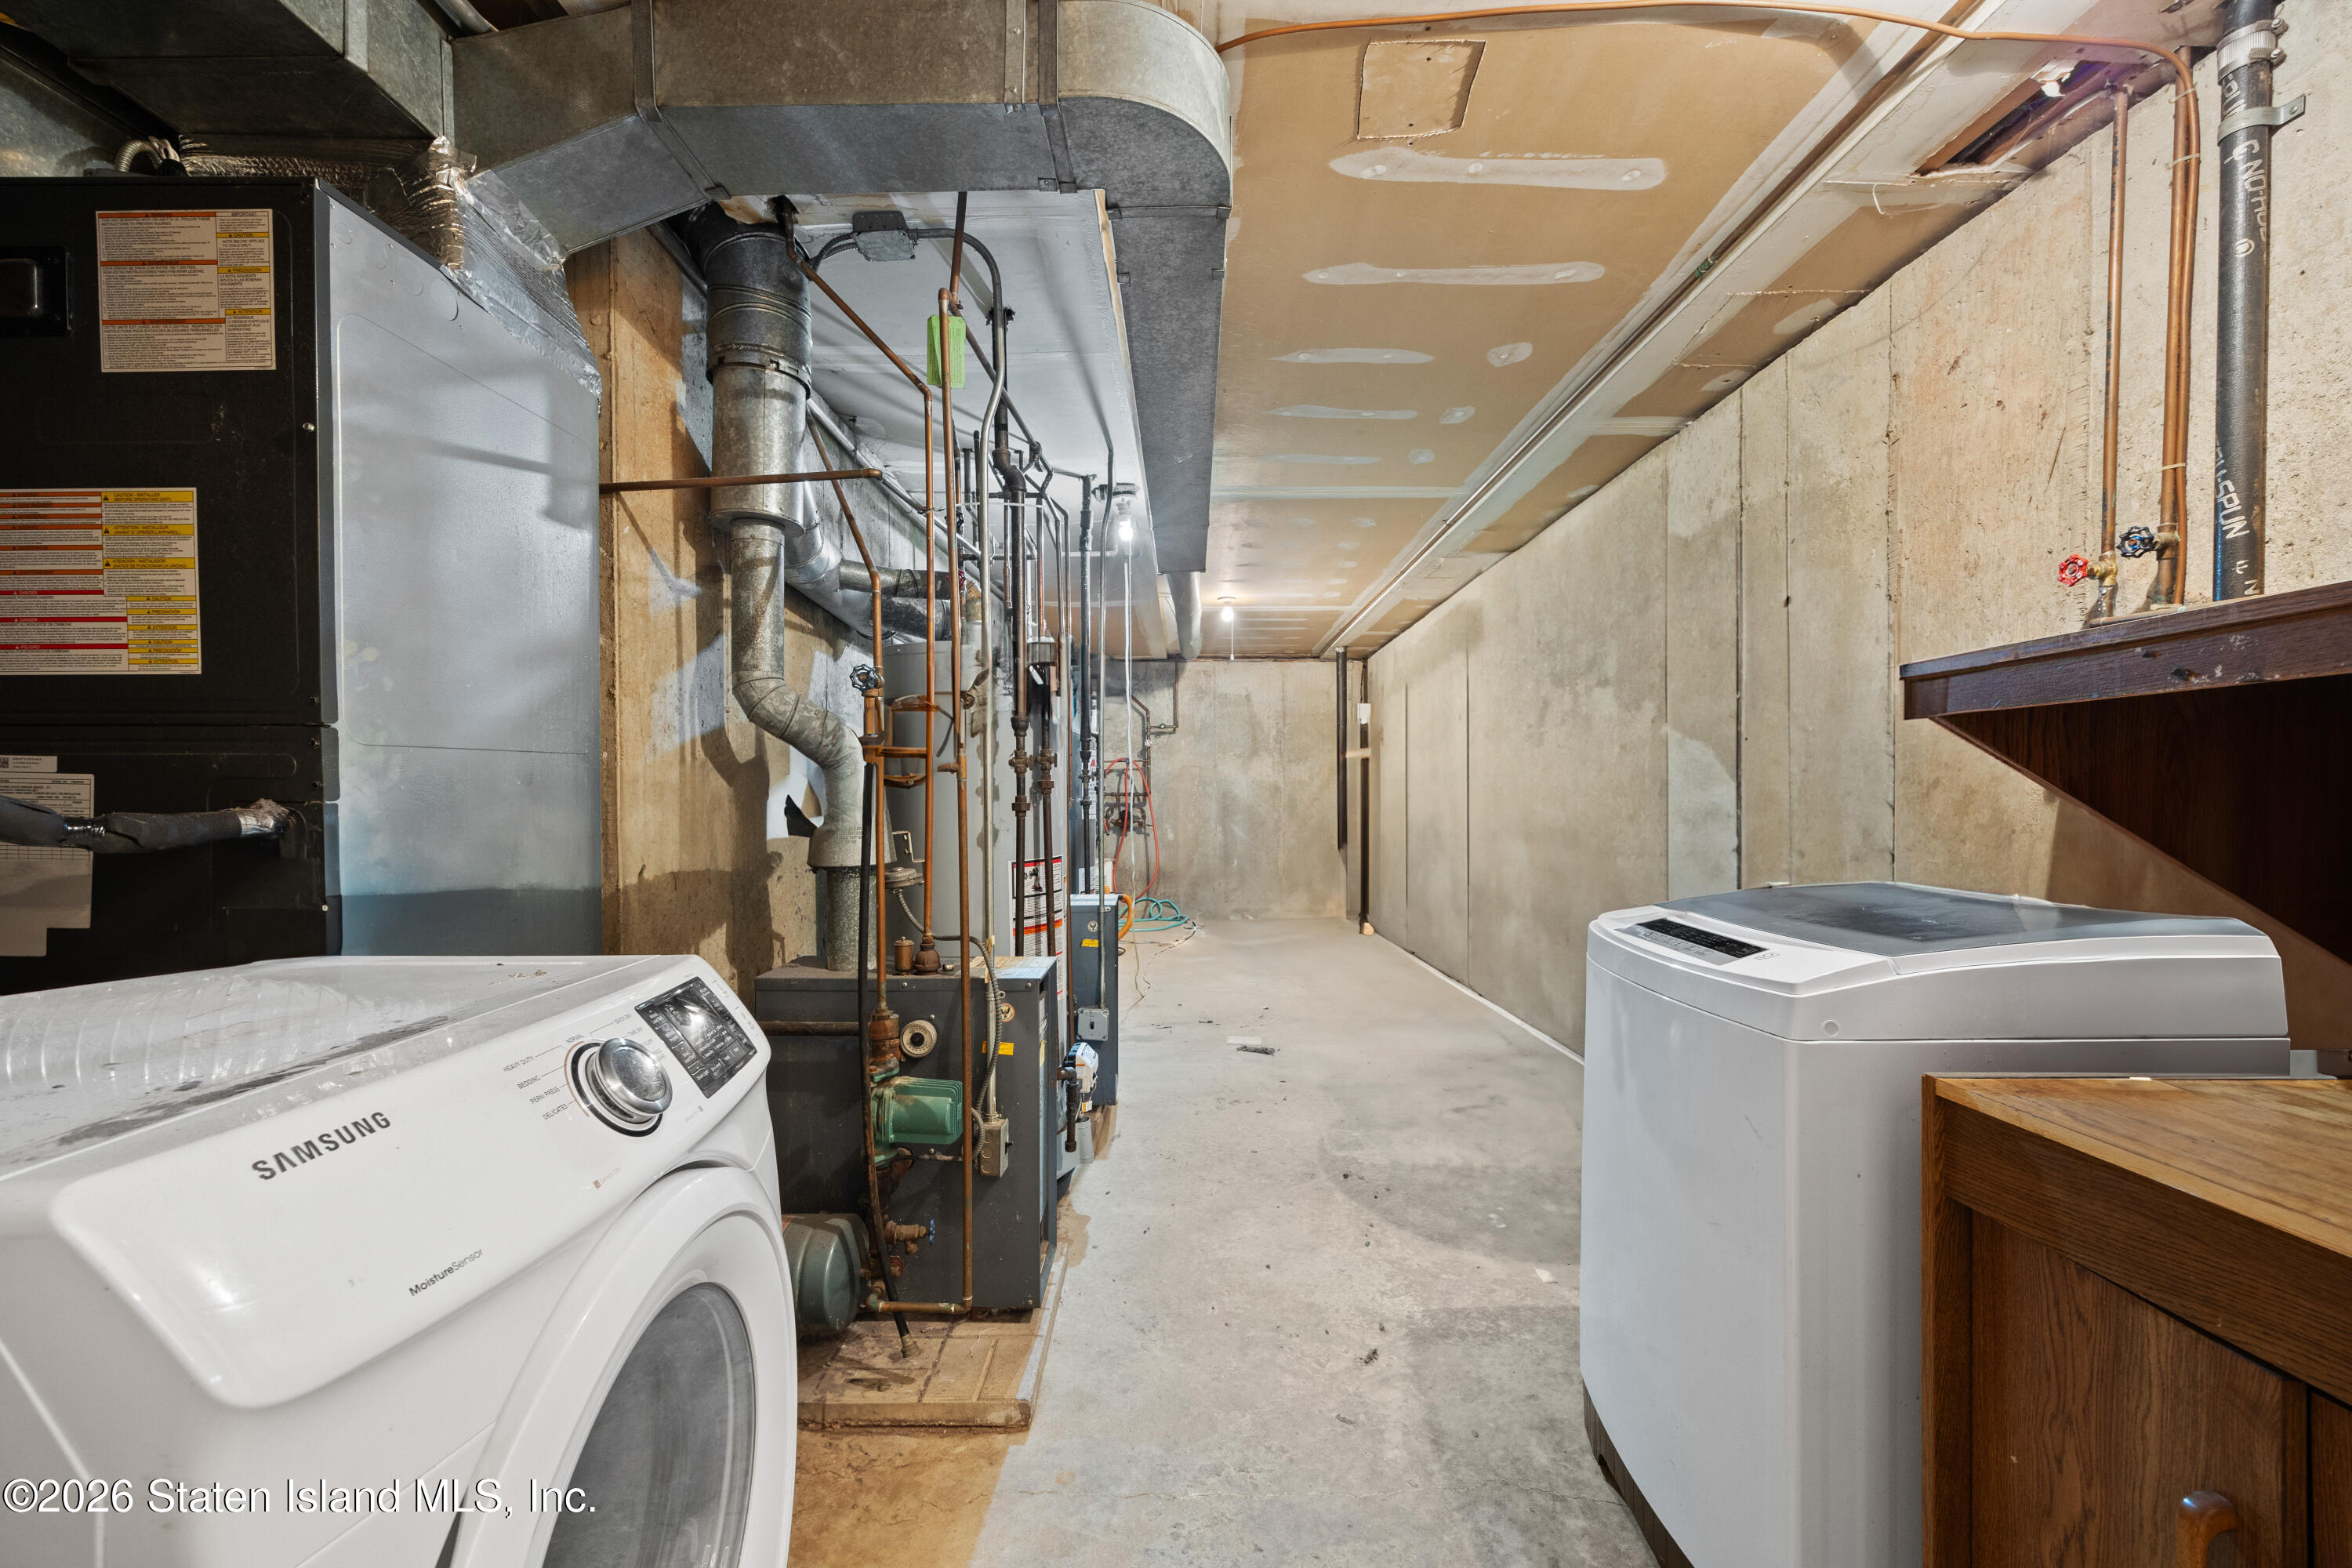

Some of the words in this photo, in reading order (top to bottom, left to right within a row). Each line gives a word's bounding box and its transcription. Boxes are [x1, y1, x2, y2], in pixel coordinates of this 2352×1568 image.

[566, 1034, 584, 1043] NORMAL
[503, 1062, 520, 1072] HEAVY
[520, 1055, 535, 1065] DUTY
[517, 1075, 541, 1090] BEDDING
[529, 1094, 545, 1104] PERM
[544, 1086, 561, 1097] PRESS
[542, 1103, 568, 1120] DELICATES
[252, 1112, 390, 1180] SAMSUNG
[408, 1248, 484, 1297] MoistureSensor
